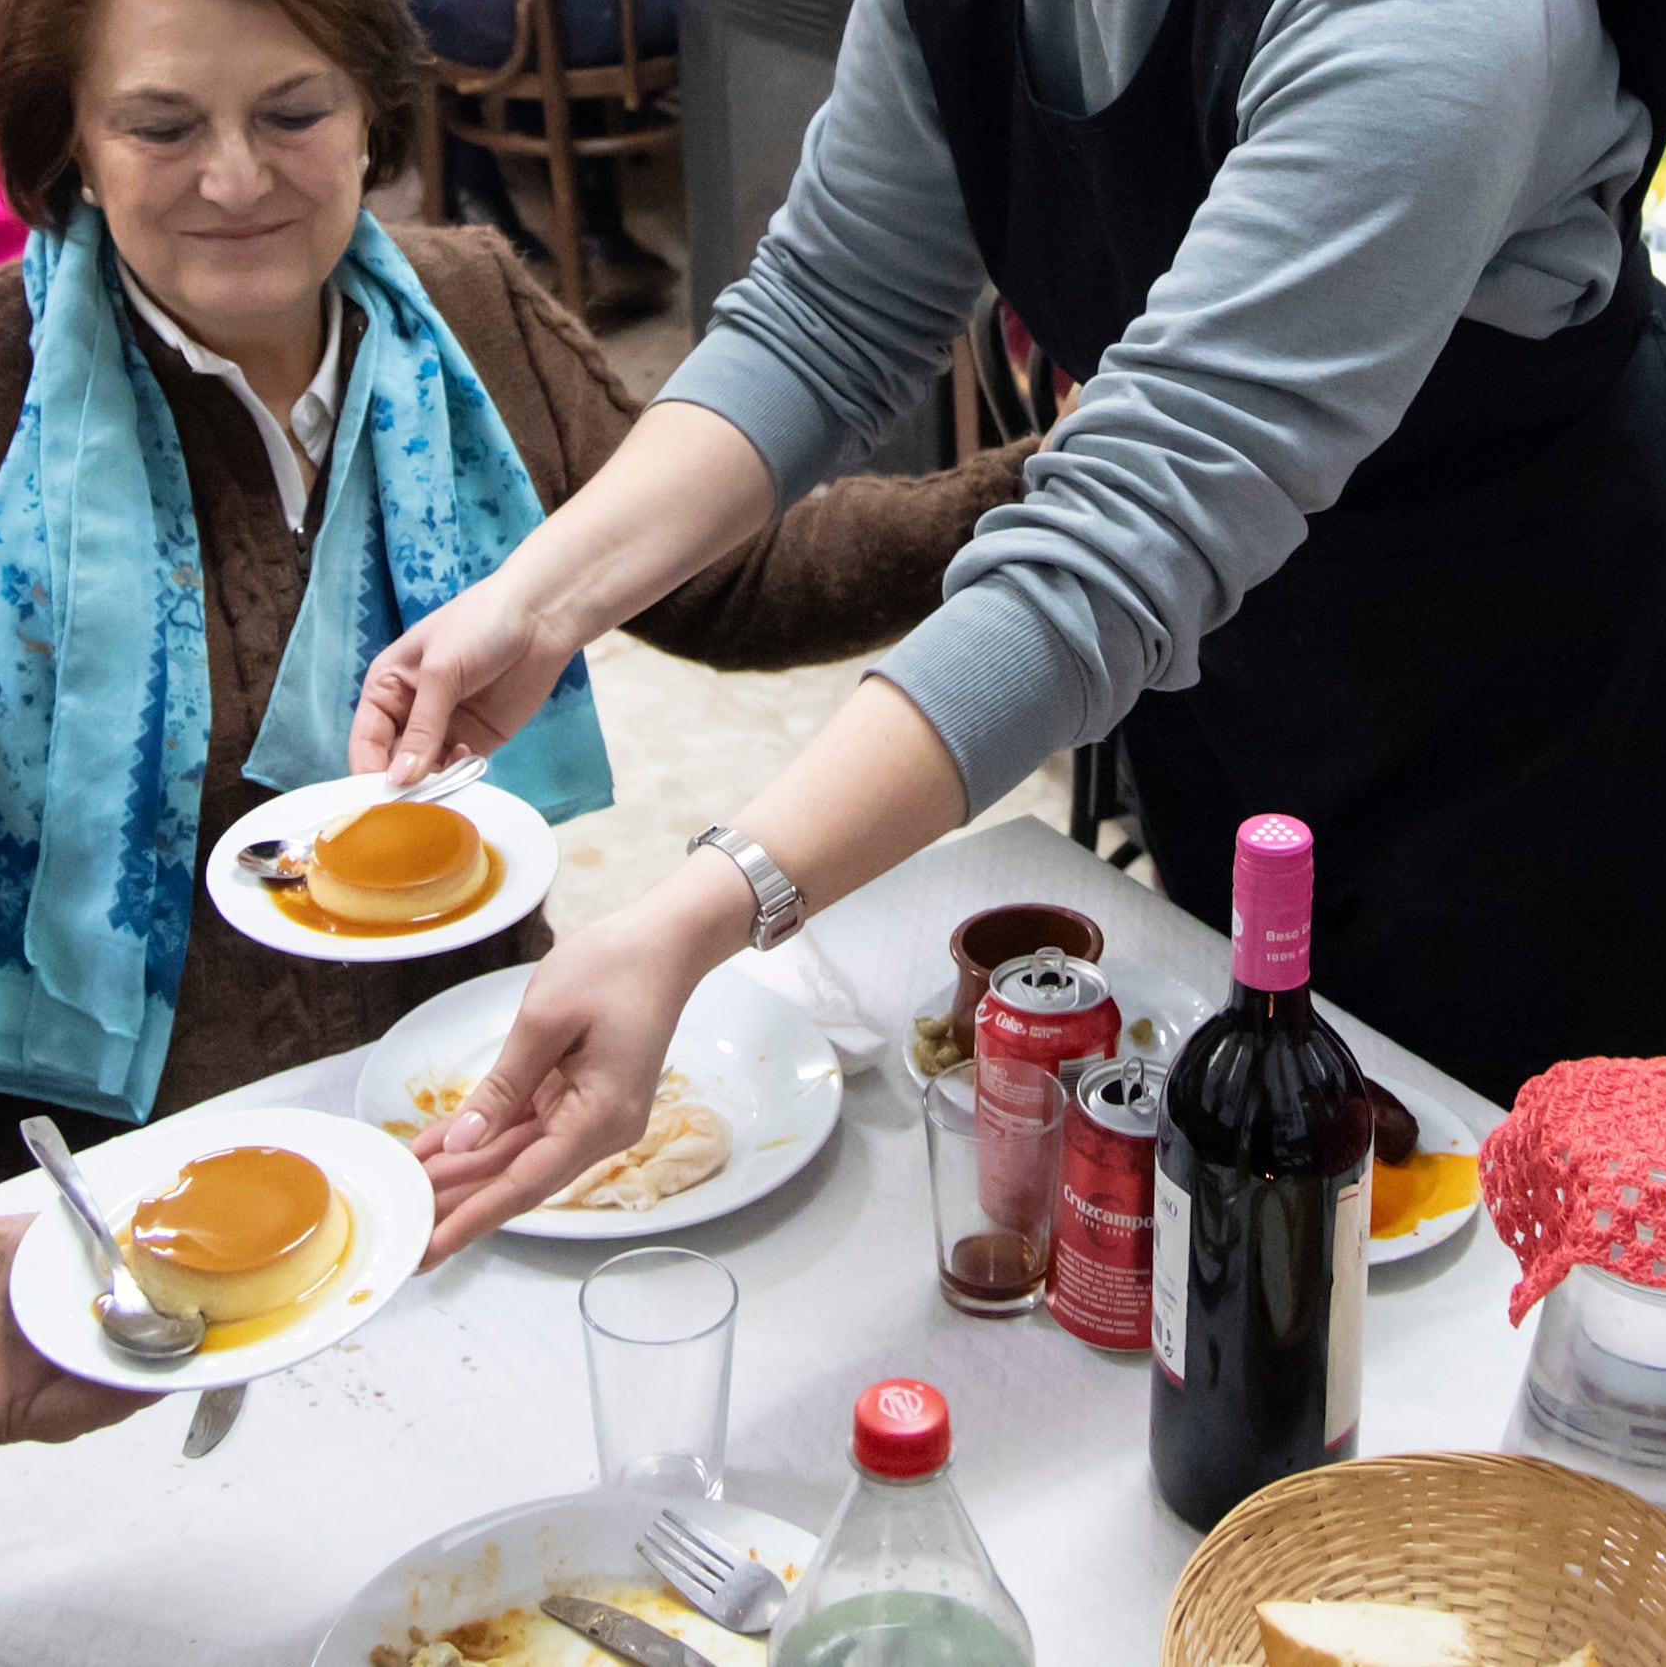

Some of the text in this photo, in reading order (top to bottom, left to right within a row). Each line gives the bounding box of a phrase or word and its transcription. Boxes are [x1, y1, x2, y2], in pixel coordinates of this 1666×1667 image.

[1265, 929, 1300, 942] Beso
[994, 1010, 1024, 1035] Coke
[1063, 1184, 1154, 1231] Cruzcampo
